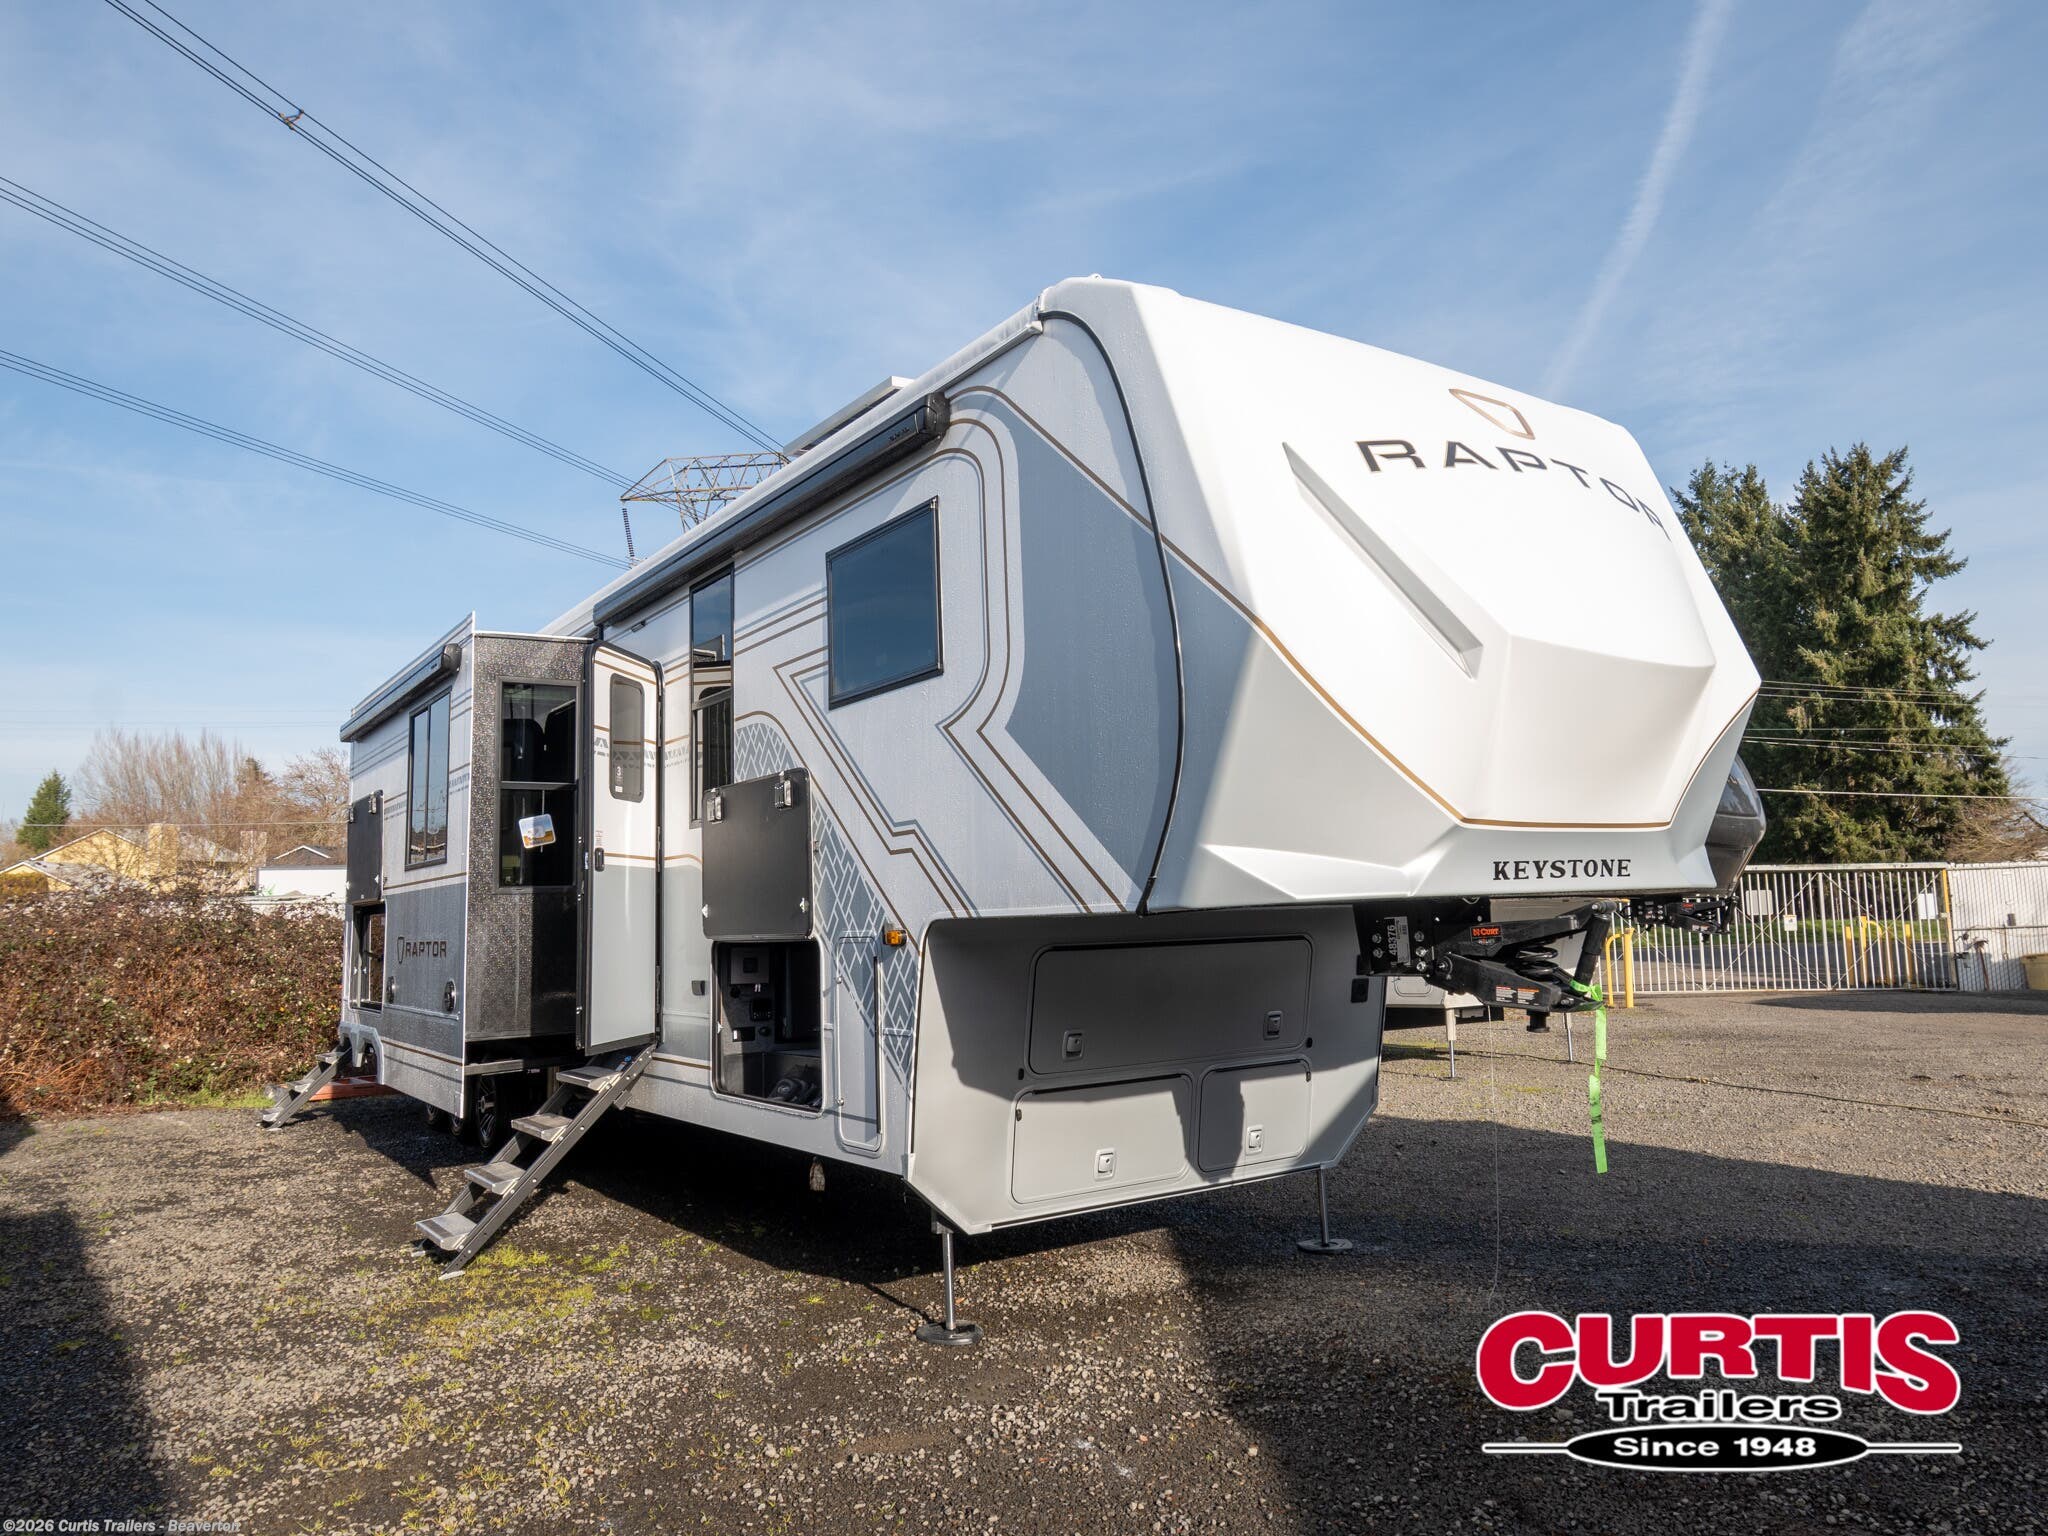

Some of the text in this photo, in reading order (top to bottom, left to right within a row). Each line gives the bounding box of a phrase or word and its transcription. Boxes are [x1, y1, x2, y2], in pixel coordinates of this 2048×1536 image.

[1355, 438, 1673, 541] RAPTOR
[1492, 858, 1632, 881] KEYSTONE
[405, 940, 448, 959] RAPTOR
